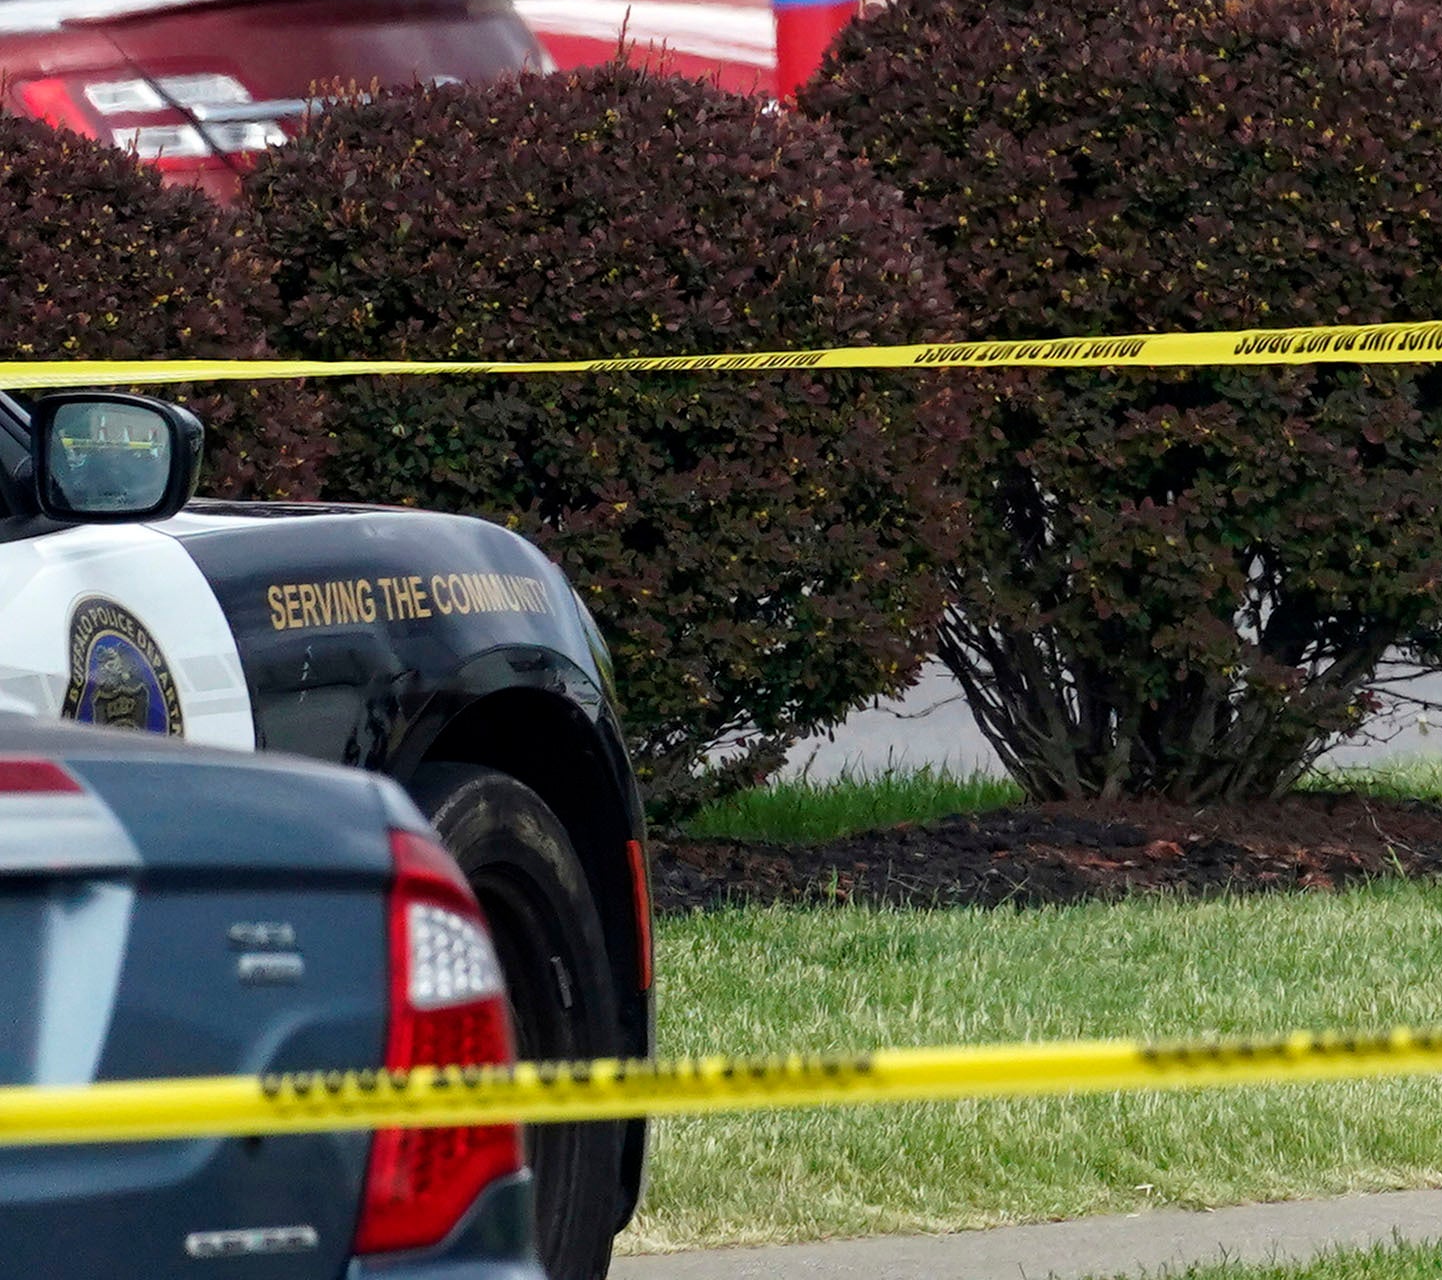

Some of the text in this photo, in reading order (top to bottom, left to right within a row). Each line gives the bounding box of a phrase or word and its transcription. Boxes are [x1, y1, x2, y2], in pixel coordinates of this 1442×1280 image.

[91, 606, 136, 638] POLICE
[267, 572, 556, 631] SERVING THE COMMUNITY
